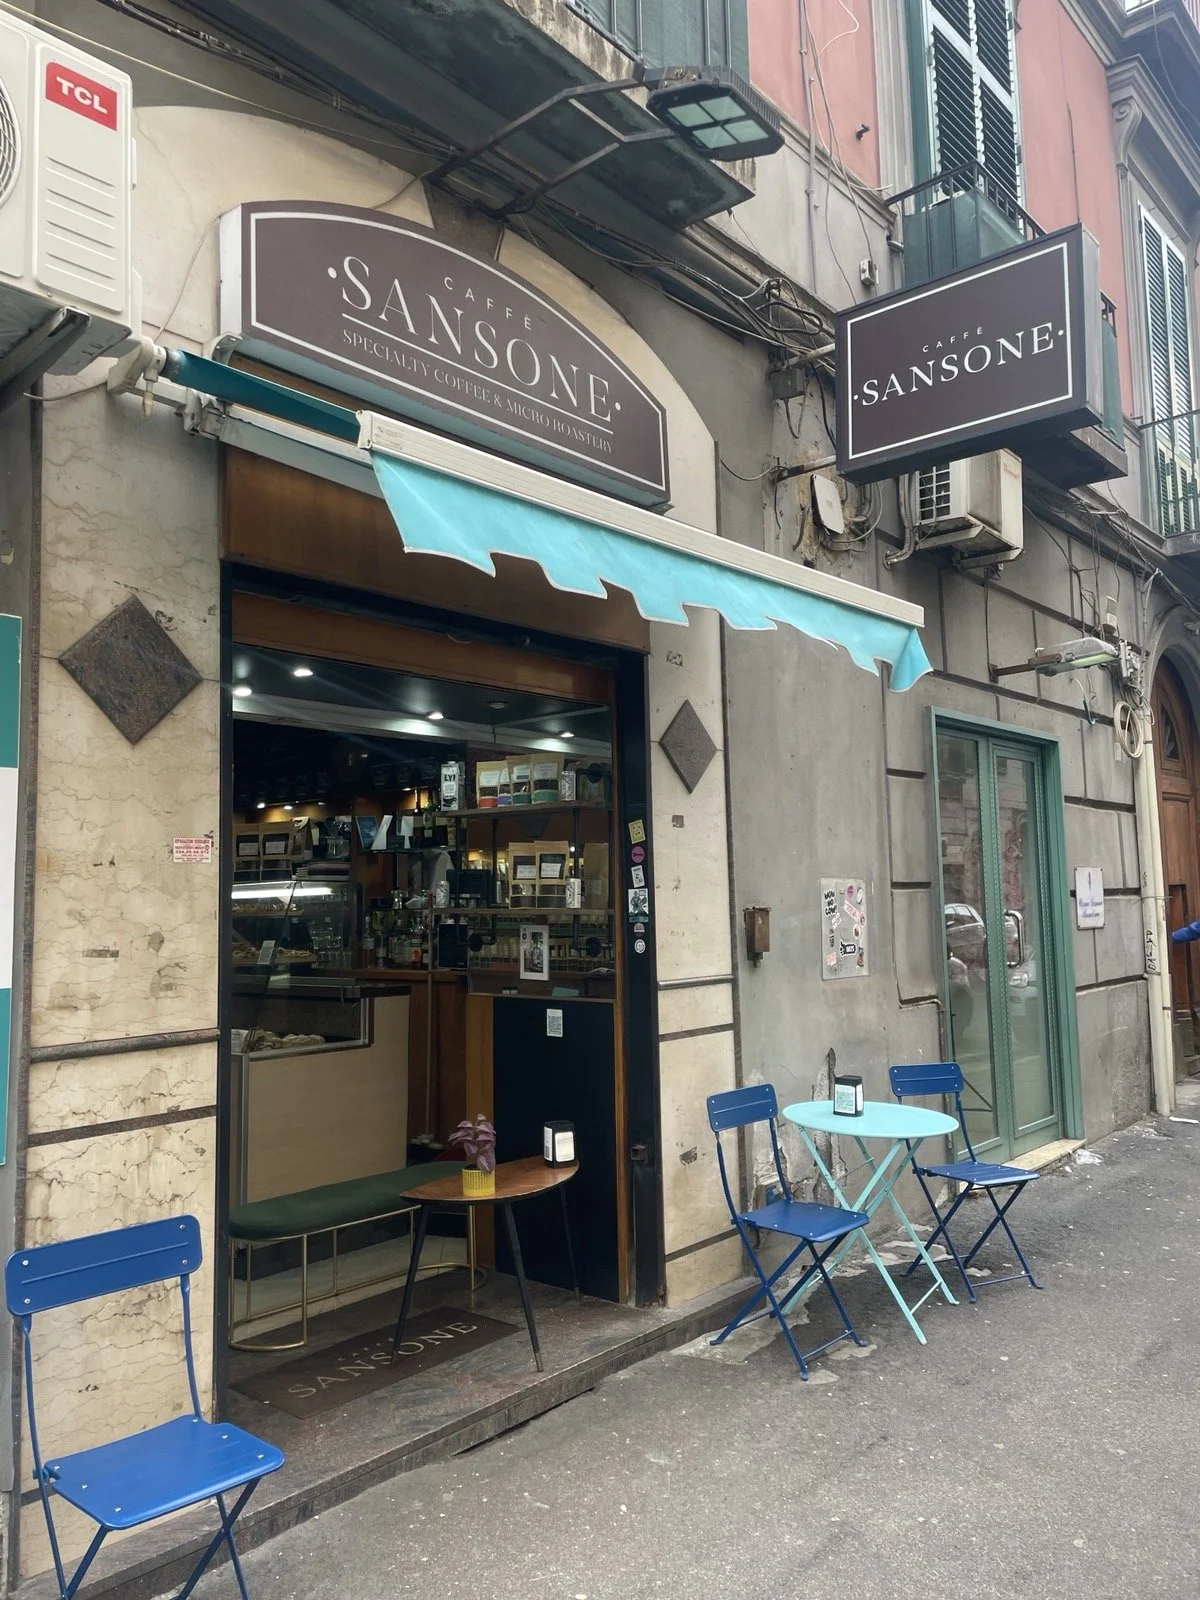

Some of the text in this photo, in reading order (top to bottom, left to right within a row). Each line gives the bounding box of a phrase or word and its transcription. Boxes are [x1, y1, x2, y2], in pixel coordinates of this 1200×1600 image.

[56, 76, 108, 115] TCL
[341, 255, 612, 422] SANSONE
[444, 276, 532, 330] CAFFÈ
[922, 324, 984, 352] CAFFÈ
[343, 329, 613, 454] SPECIALTY COFFEE & MICRO ROASTERY
[861, 322, 1054, 406] SANSONE
[288, 1322, 478, 1399] SANSONE
